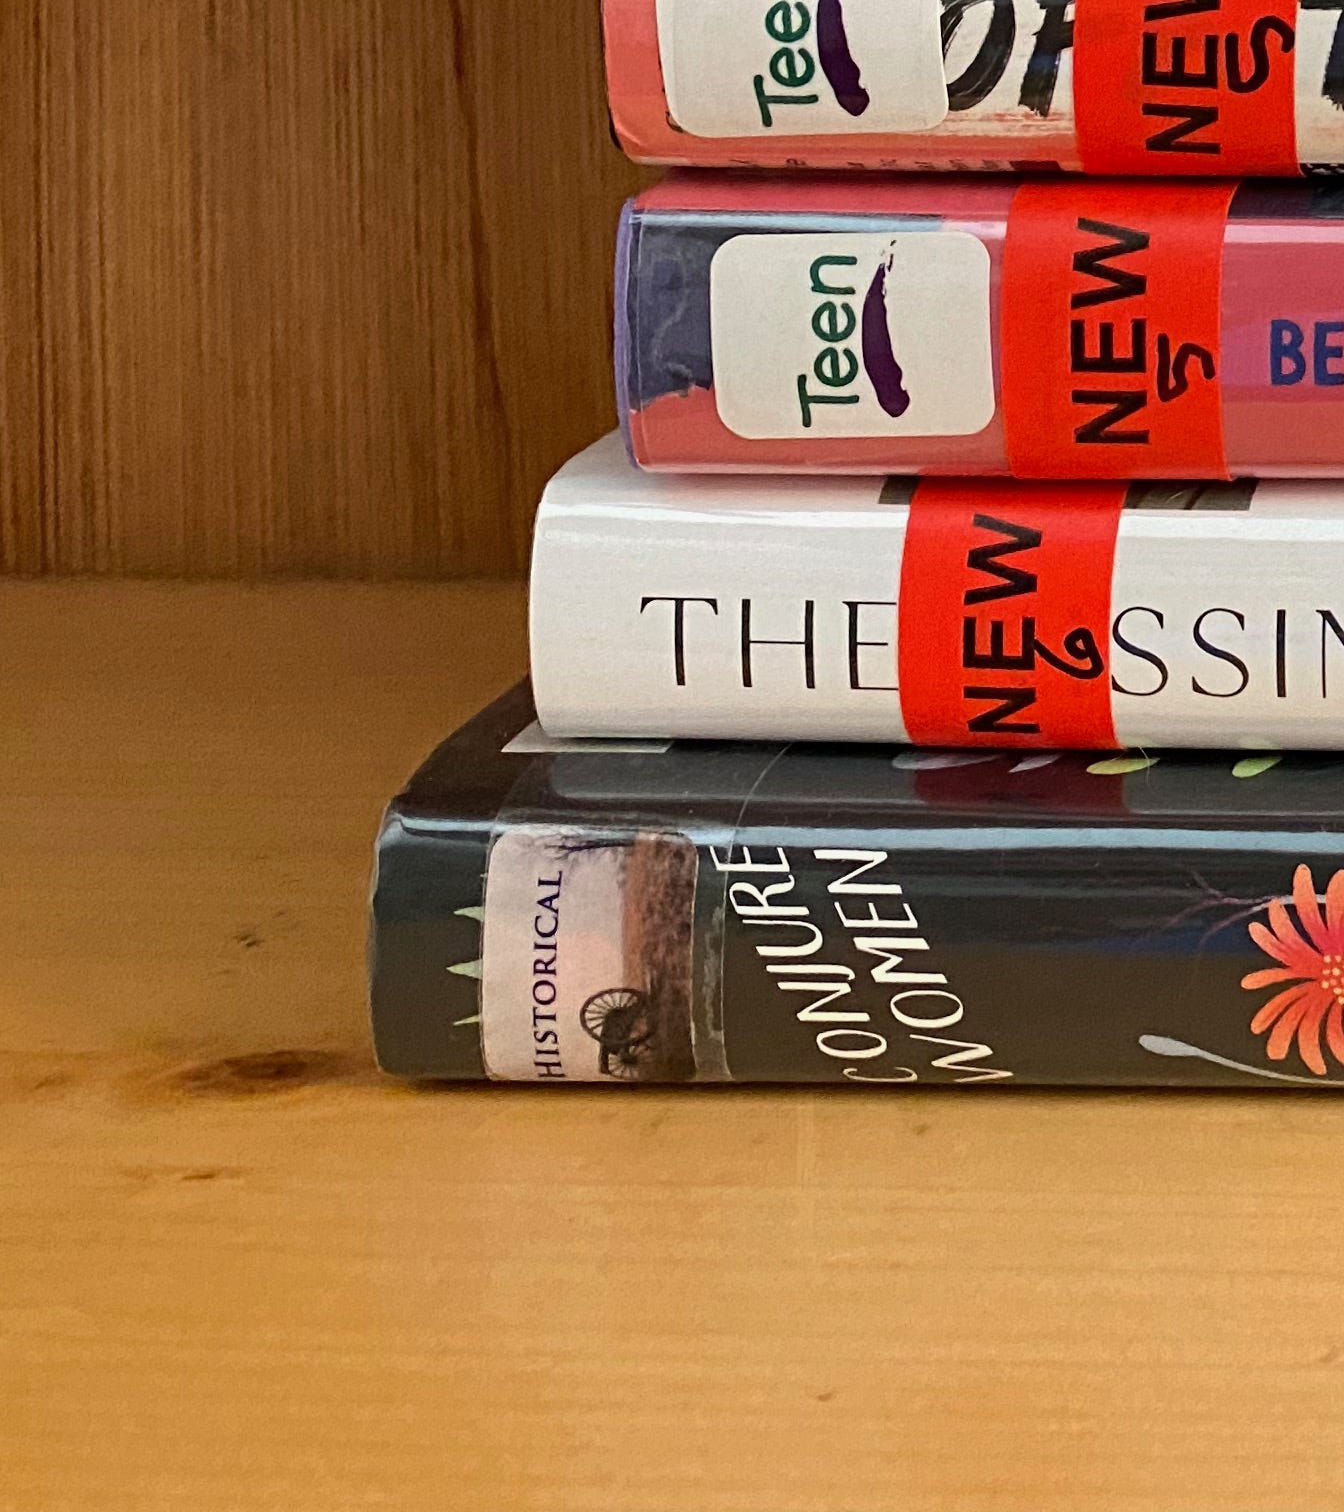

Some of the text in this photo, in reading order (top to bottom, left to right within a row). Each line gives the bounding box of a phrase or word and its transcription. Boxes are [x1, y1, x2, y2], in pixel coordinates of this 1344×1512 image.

[799, 254, 861, 429] Teen
[1070, 217, 1151, 445] NEW
[1157, 334, 1217, 403] 5
[638, 595, 899, 691] THE
[962, 514, 1044, 736] NEW
[534, 869, 566, 1080] HISTORICAL
[709, 844, 919, 1084] CONJURE
[812, 848, 1016, 1084] WOMEN
